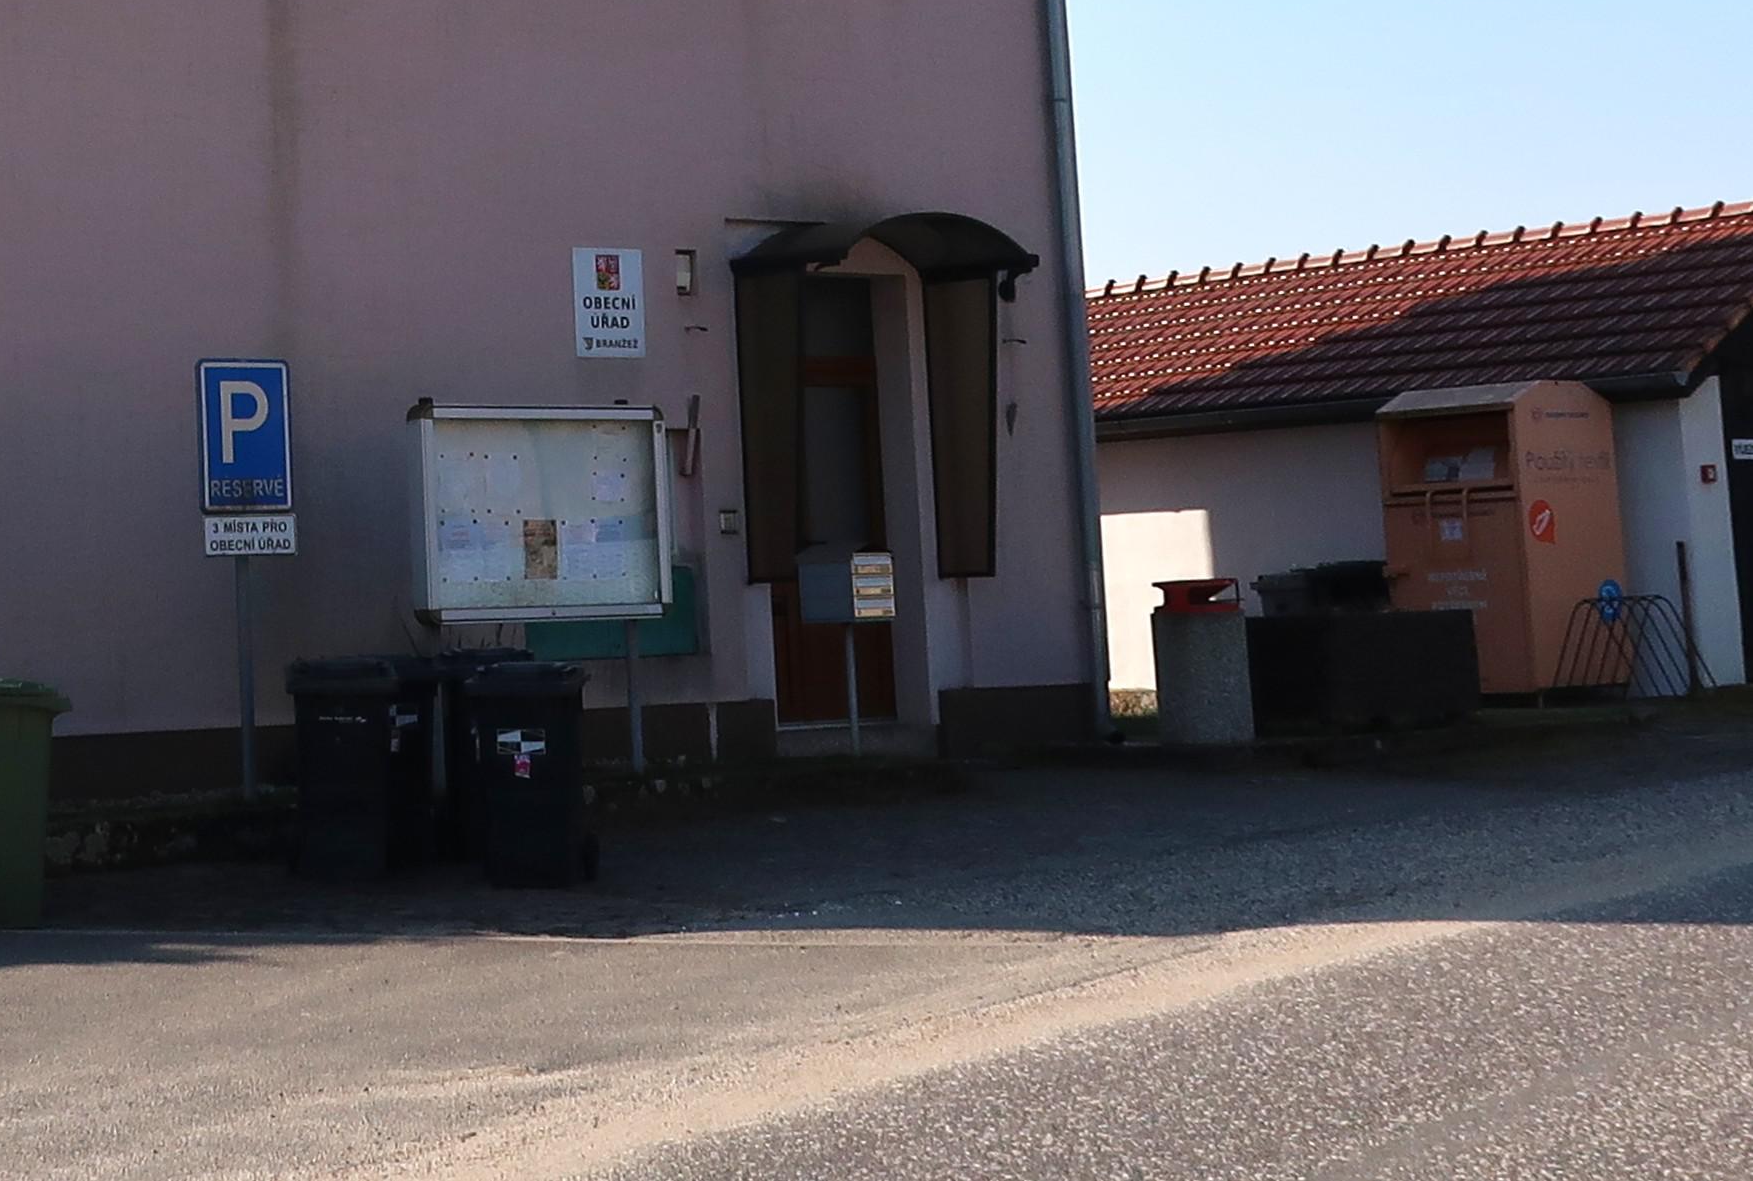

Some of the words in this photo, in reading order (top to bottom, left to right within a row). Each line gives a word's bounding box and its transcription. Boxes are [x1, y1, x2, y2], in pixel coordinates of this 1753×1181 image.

[583, 294, 636, 310] OBECNÍ
[591, 312, 630, 329] ÚŘAD
[596, 338, 638, 349] BRANŽEŽ
[219, 380, 269, 464] P
[212, 523, 219, 534] 3
[223, 519, 259, 533] MÍSTA
[210, 537, 255, 551] OBECNÍ
[258, 537, 291, 550] ÚŘAD
